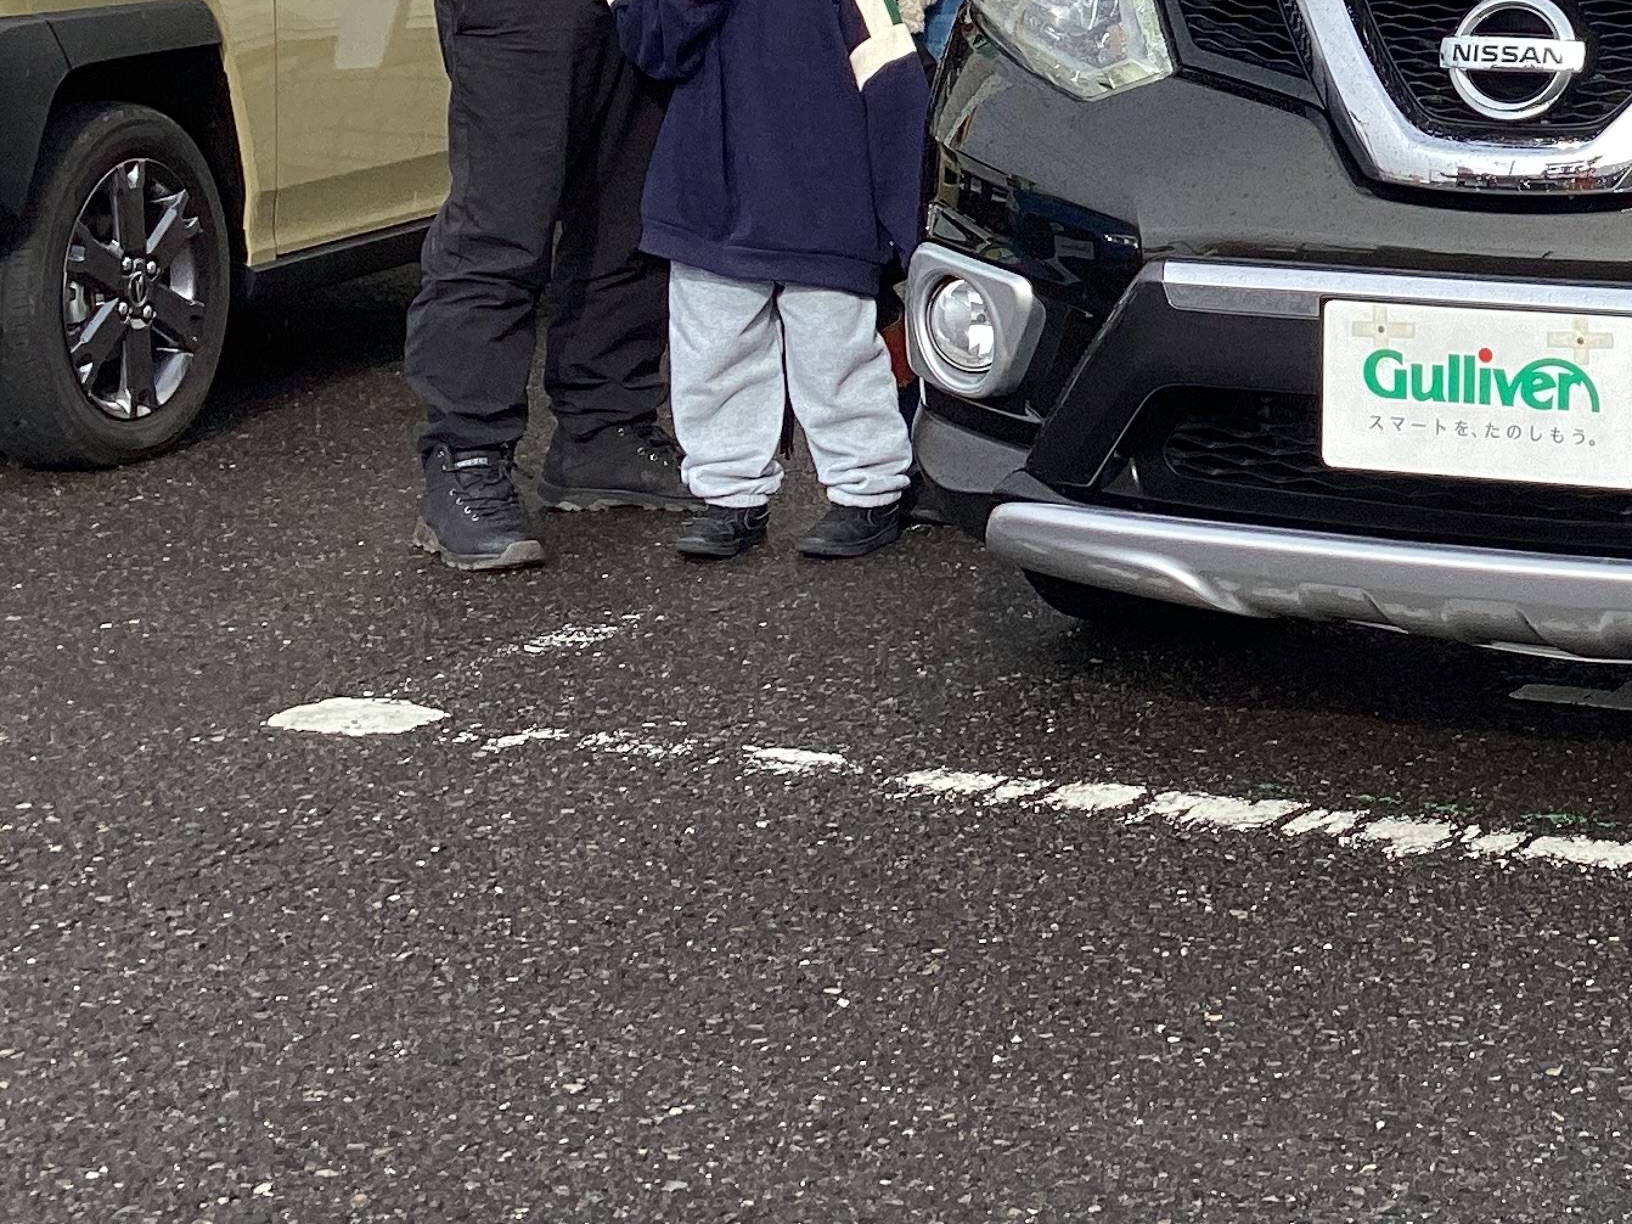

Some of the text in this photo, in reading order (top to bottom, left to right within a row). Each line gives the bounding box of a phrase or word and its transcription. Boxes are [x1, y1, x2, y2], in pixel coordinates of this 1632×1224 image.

[1452, 43, 1564, 65] NISSAN
[1362, 347, 1600, 413] Gulliver
[1368, 414, 1597, 447] スマートを、たのしもう。
